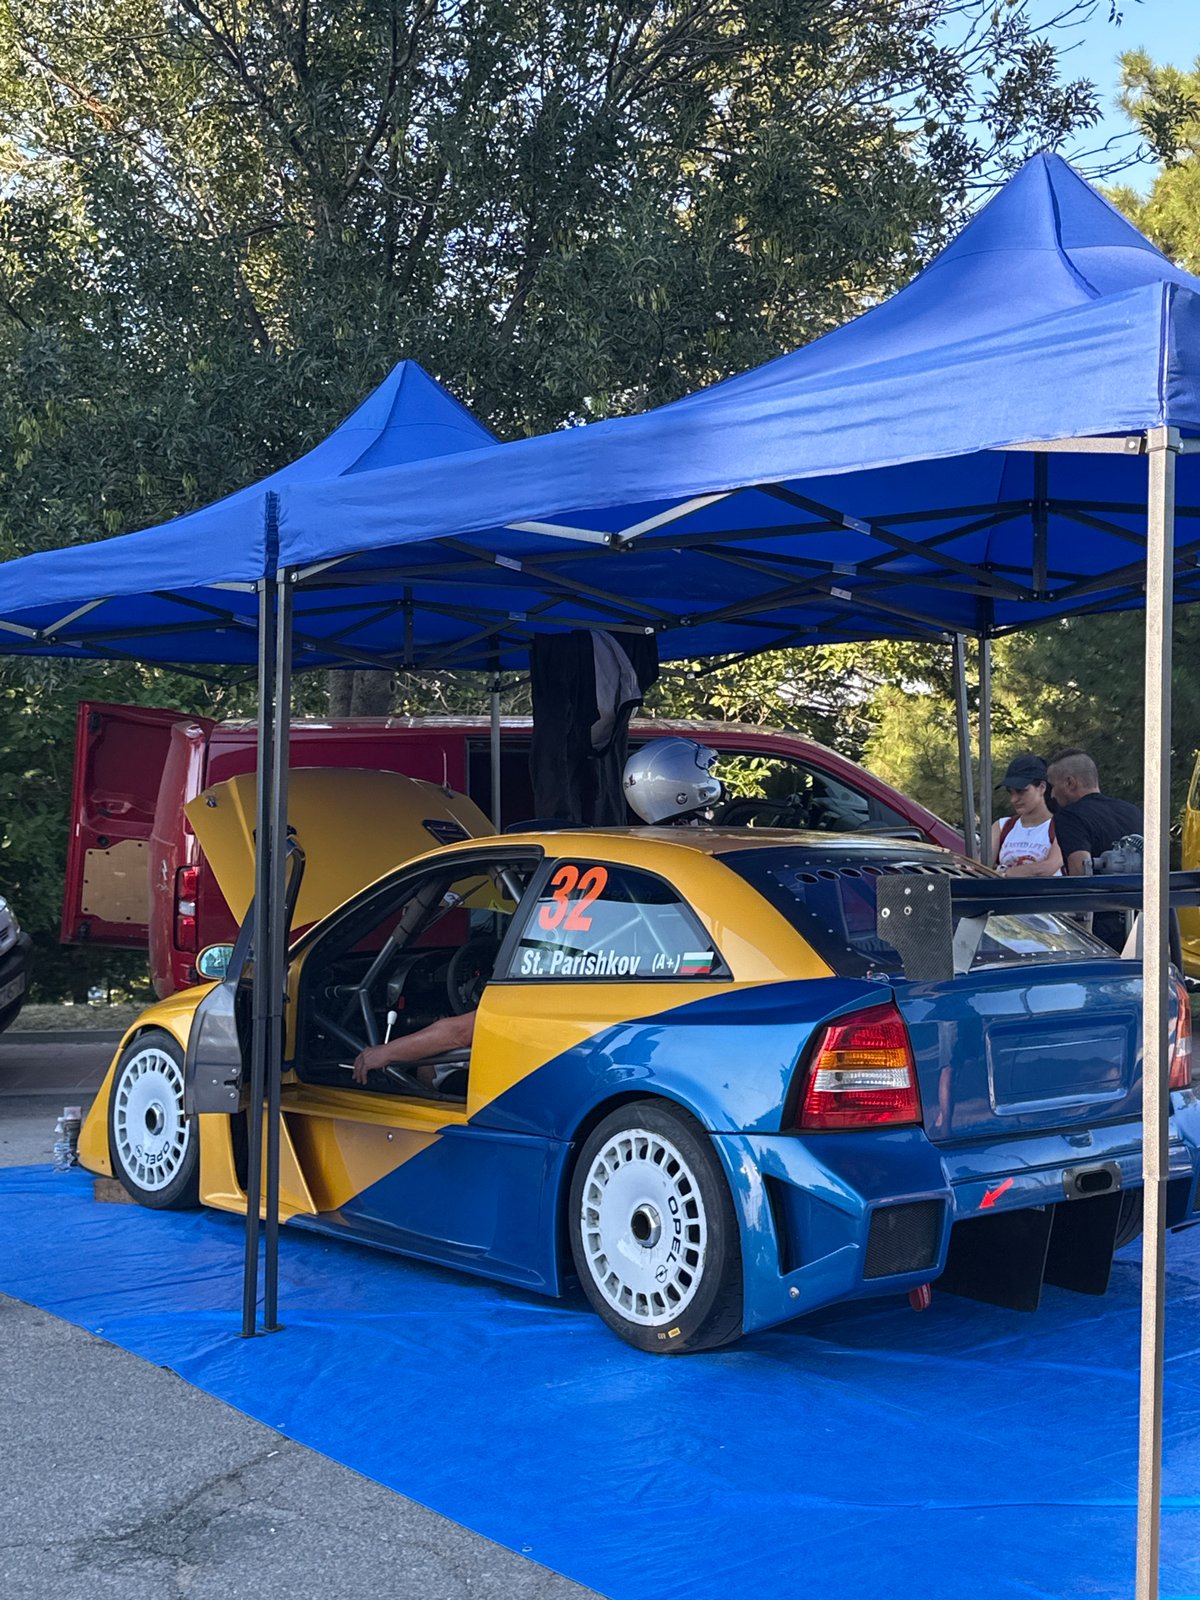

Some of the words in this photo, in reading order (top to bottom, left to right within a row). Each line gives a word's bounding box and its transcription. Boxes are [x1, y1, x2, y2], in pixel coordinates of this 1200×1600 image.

[538, 865, 608, 931] 32
[521, 949, 544, 975] St.
[551, 950, 641, 975] Parishkov
[652, 953, 681, 974] (A+)
[144, 1140, 170, 1165] OPEL
[666, 1195, 682, 1263] OPEL
